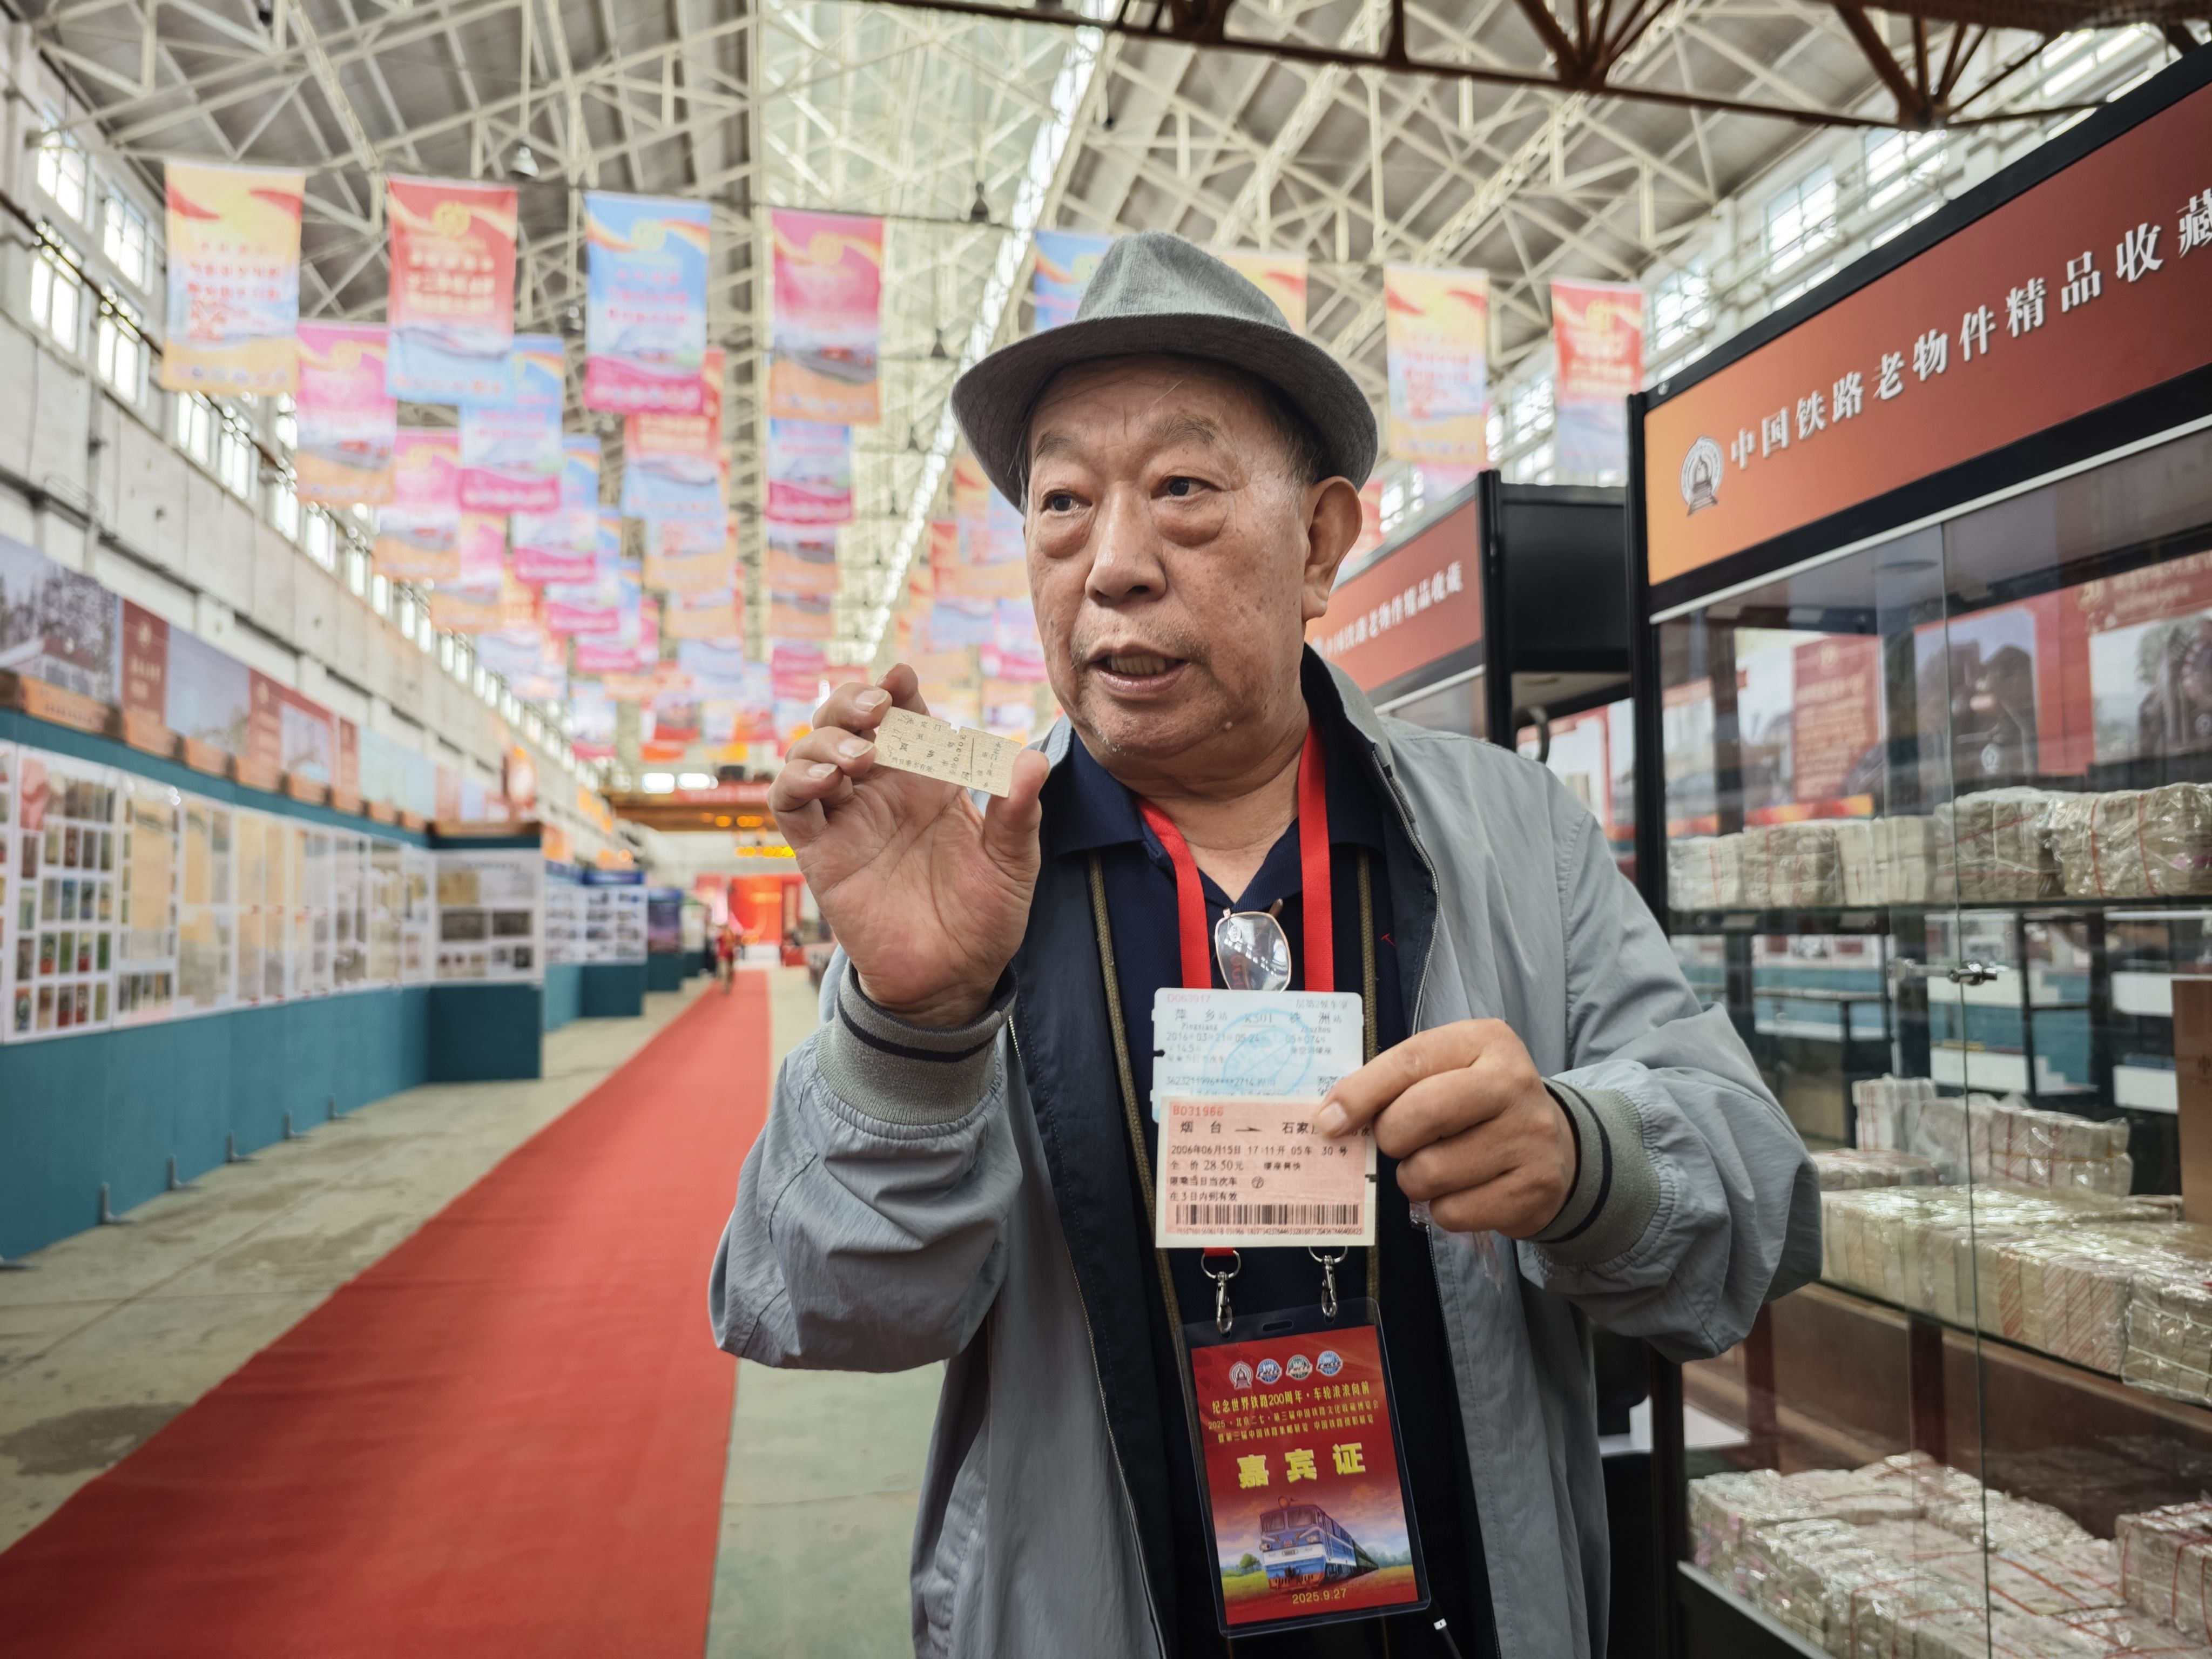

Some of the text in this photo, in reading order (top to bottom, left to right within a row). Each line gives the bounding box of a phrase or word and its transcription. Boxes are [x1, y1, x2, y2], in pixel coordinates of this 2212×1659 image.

[1730, 189, 2212, 470] 中国铁路老物件精品收藏
[1173, 1105, 1224, 1117] B031966
[1180, 1121, 1222, 1134] 烟台
[1282, 1121, 1318, 1135] 石家
[1237, 1442, 1366, 1489] 嘉宾证
[1292, 1588, 1347, 1604] 2025.9.27
